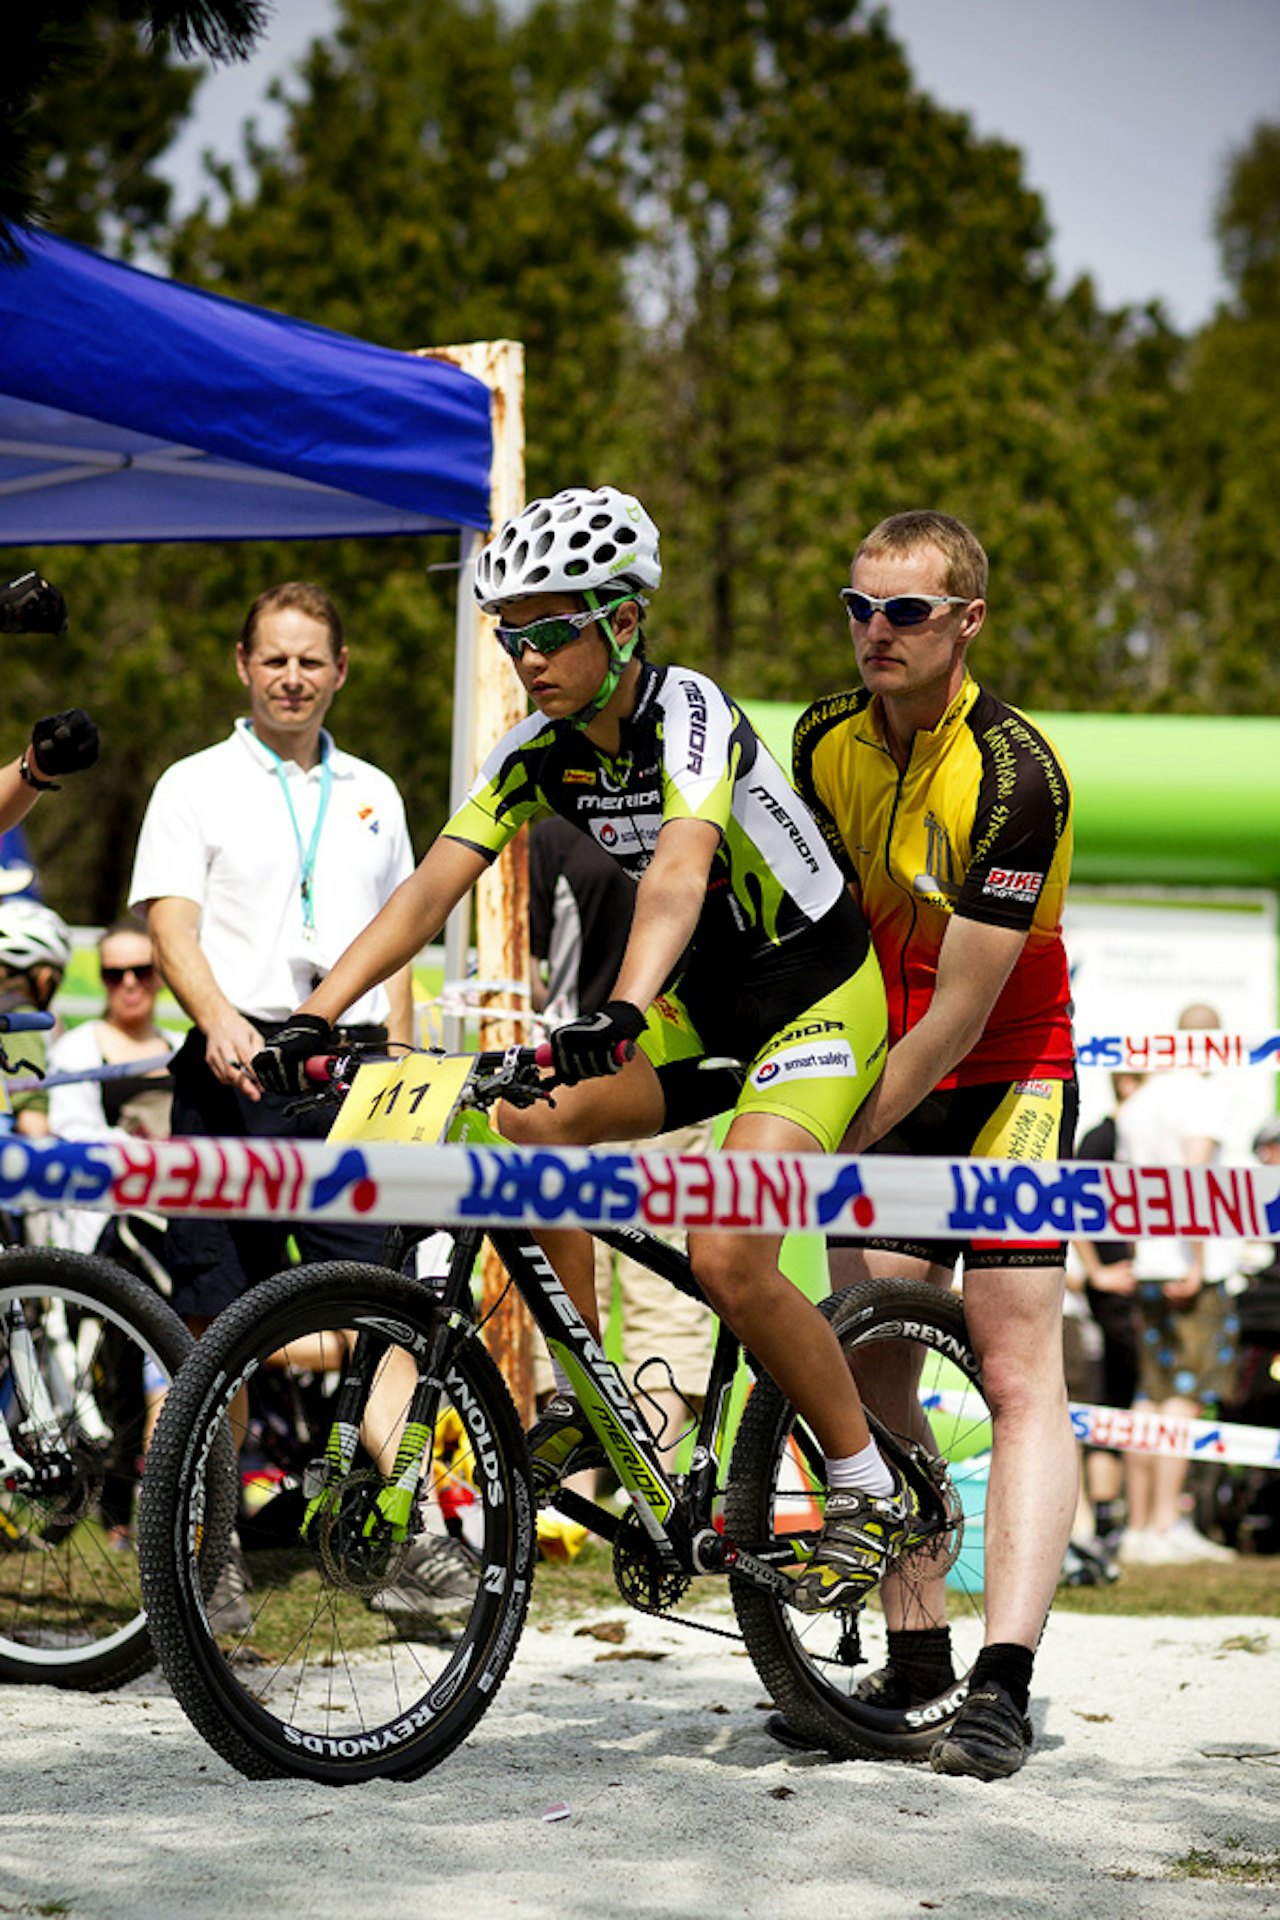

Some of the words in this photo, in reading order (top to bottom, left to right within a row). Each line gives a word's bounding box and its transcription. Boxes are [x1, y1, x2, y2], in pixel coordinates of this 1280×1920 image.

[679, 679, 706, 776] MERIDA
[577, 789, 660, 810] MERIDA
[749, 785, 819, 875] MERIDA
[985, 868, 1044, 892] BIKE
[784, 1054, 816, 1071] smart
[818, 1051, 850, 1067] safety
[1076, 1035, 1243, 1069] INTERSP
[367, 1079, 431, 1120] 111
[0, 1136, 306, 1211] INTERSPO
[458, 1150, 809, 1228] INTERSPORT
[947, 1164, 1260, 1236] INTERSPORT
[518, 1244, 654, 1443] MERIDA
[902, 1320, 982, 1378] REYNO
[591, 1404, 666, 1508] MERIDA
[1068, 1411, 1189, 1451] INTERS
[282, 1705, 436, 1757] REYNOLDS
